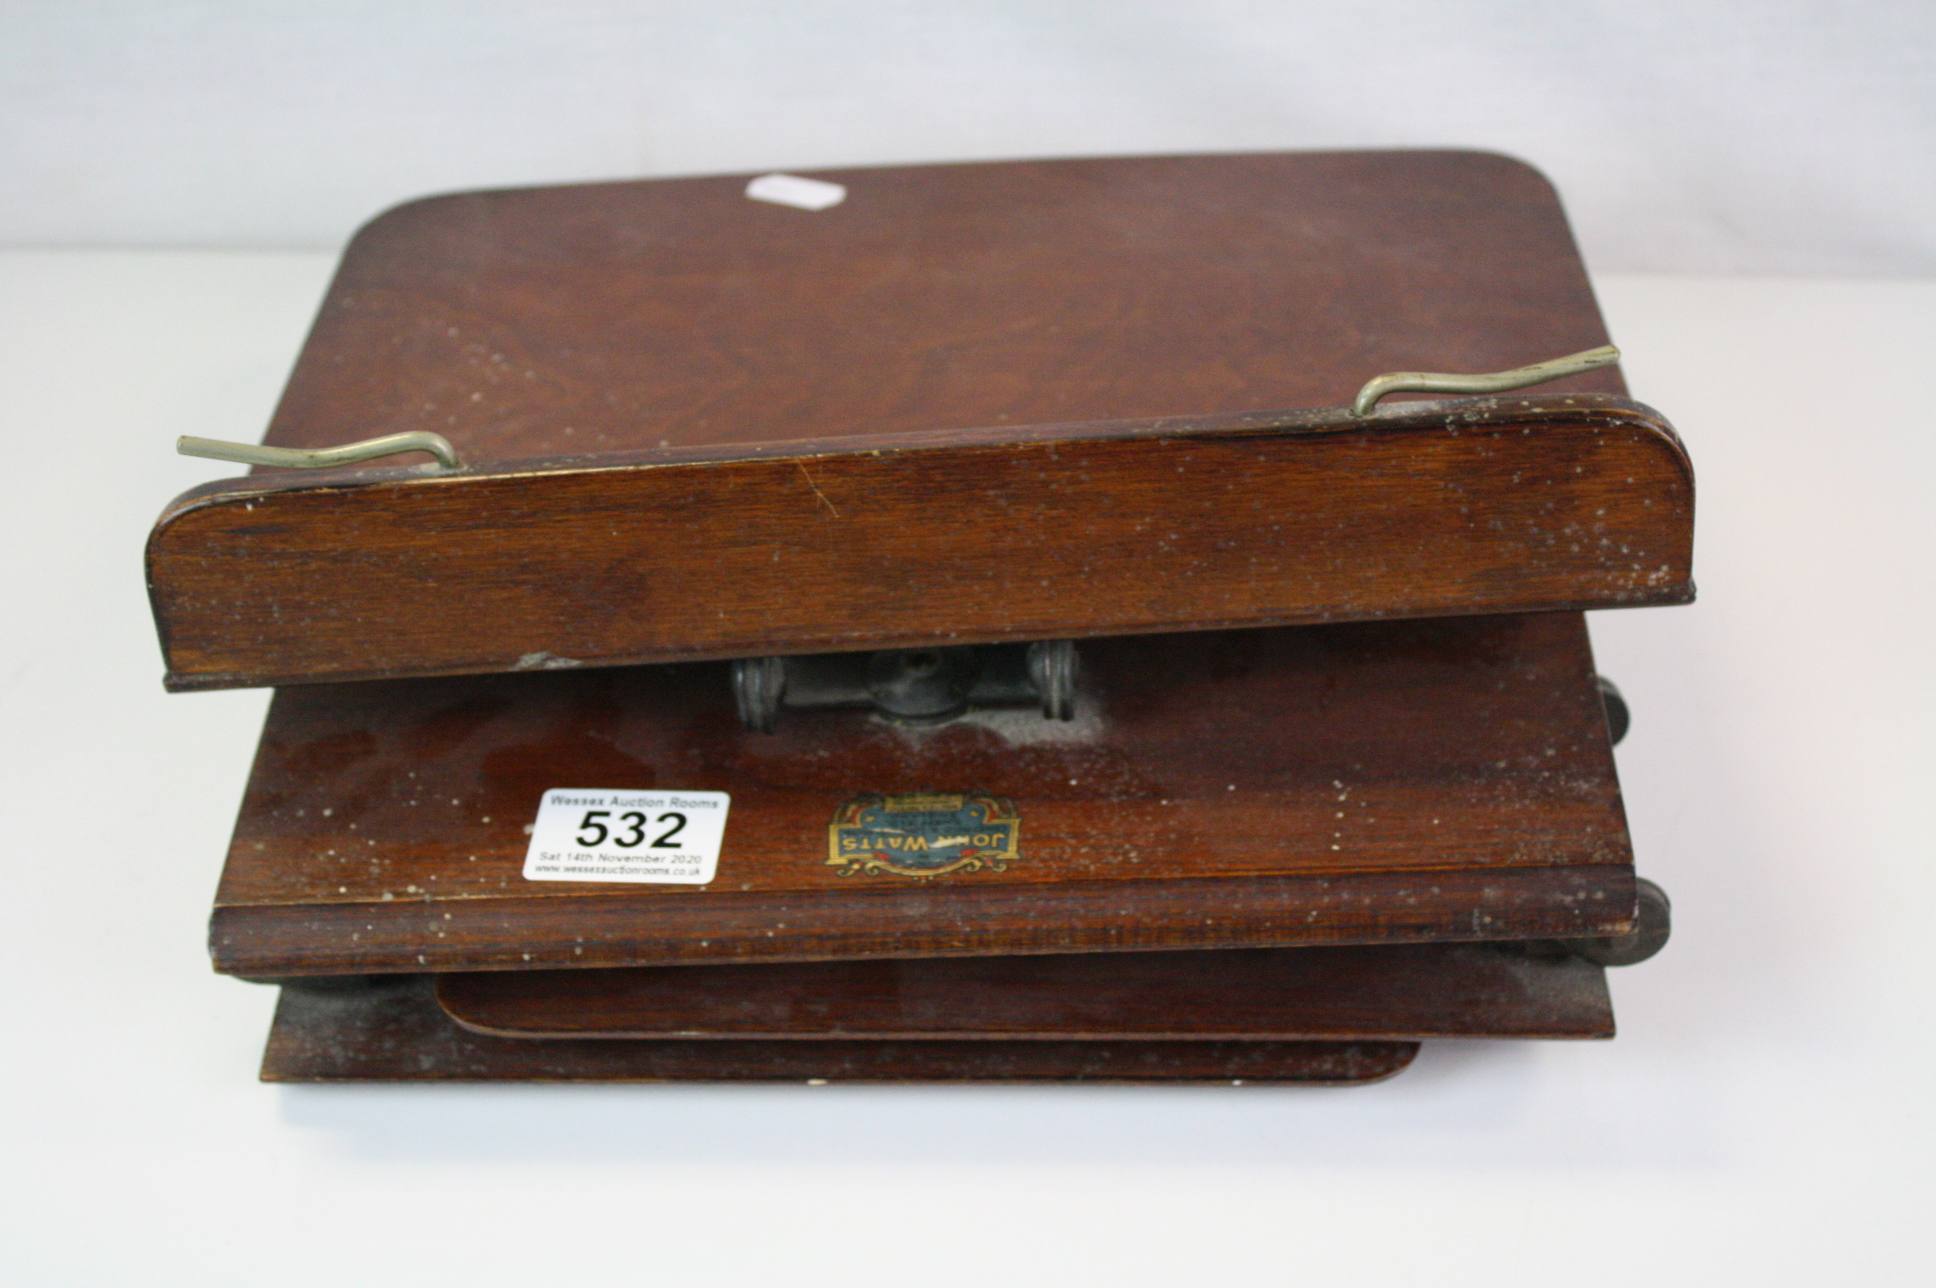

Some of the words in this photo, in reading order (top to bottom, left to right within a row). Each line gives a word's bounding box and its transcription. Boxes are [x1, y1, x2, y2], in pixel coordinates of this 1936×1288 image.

[550, 795, 604, 806] Wessex
[610, 796, 665, 807] Auction
[669, 797, 719, 808] Rooms
[575, 810, 687, 849] 532
[843, 835, 929, 852] WATTS
[539, 852, 561, 862] Sat
[567, 852, 593, 862] 14th
[598, 853, 666, 864] November
[670, 854, 702, 864] 2020
